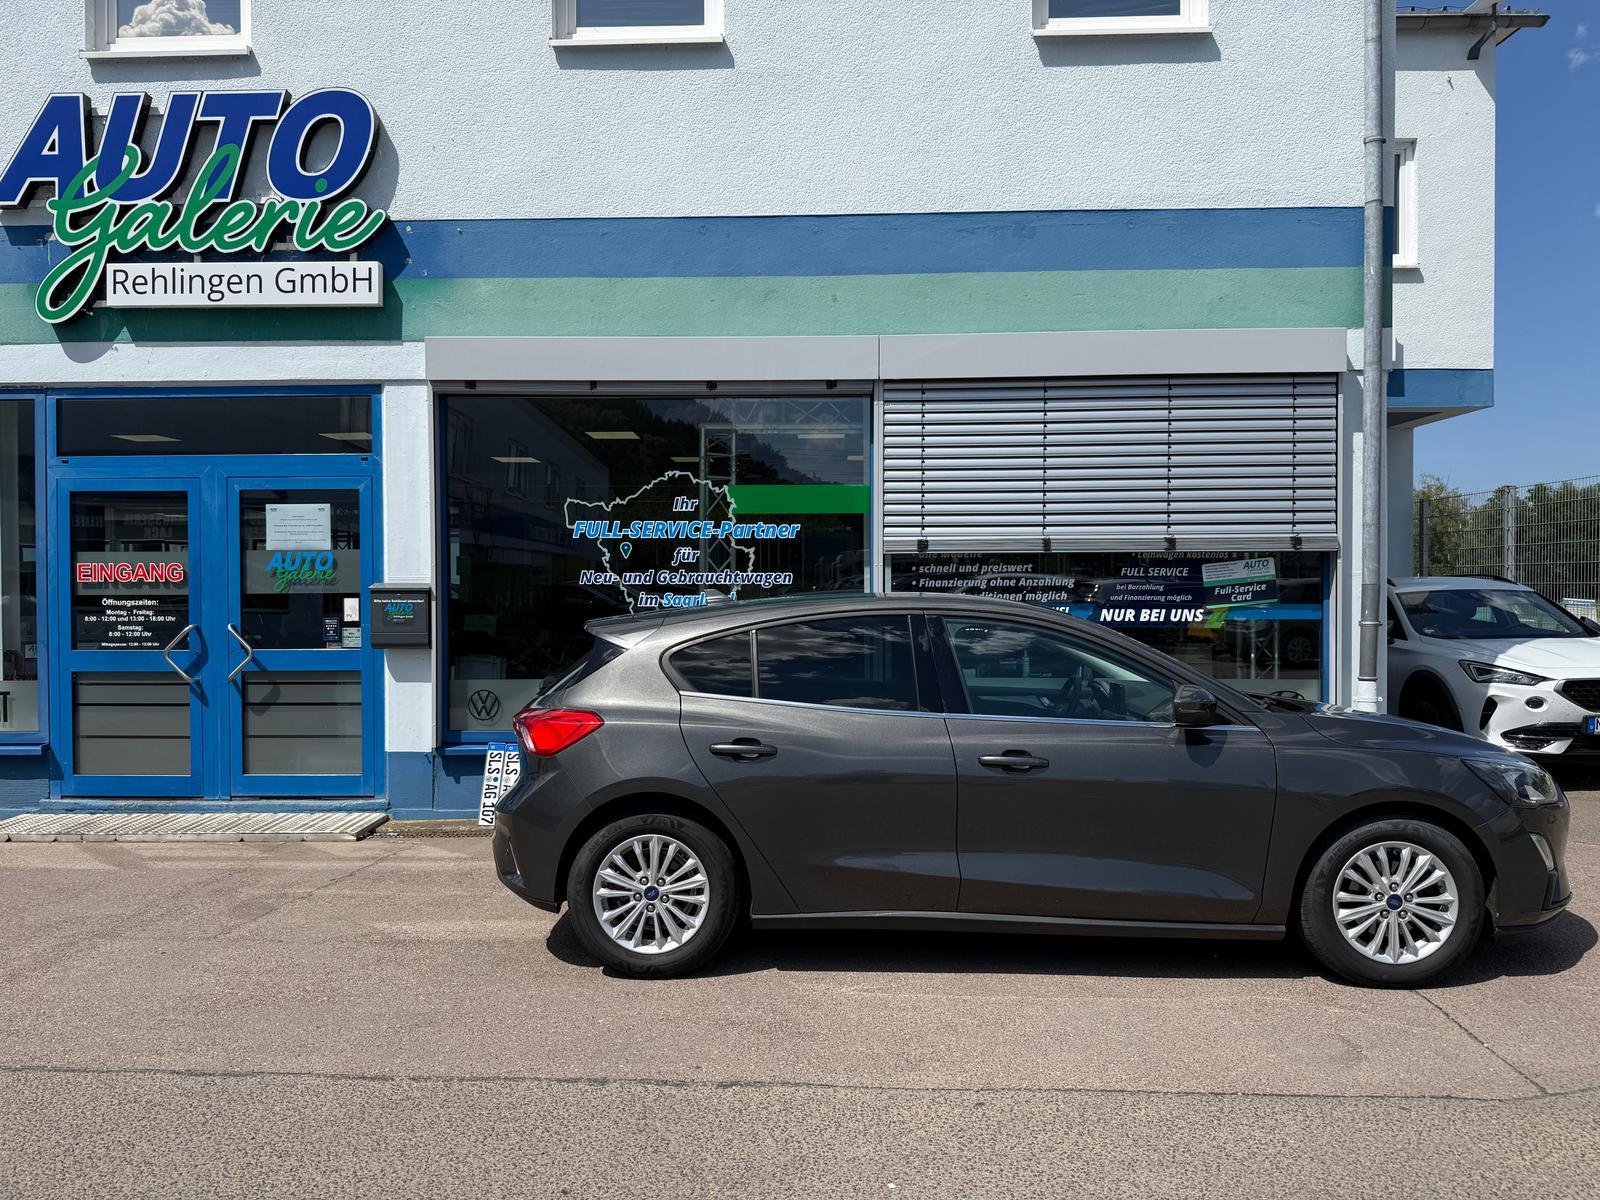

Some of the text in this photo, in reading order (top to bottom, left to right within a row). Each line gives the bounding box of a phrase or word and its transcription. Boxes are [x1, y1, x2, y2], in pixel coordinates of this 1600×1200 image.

[0, 88, 375, 205] AUTO
[112, 267, 373, 302] Rehlingen GmbH
[672, 496, 699, 512] Ihr
[572, 520, 801, 539] FULL-SERVICE-Partner
[266, 551, 334, 572] AUTO
[671, 547, 700, 567] für
[1243, 559, 1269, 569] AUTO
[76, 562, 184, 583] EINGANG
[918, 562, 1033, 575] schnell und preiswert
[1120, 567, 1189, 577] FULL SERVICE
[579, 569, 793, 589] Neu- und Gebrauchtwagen
[918, 576, 1075, 590] Finanzierung ohne Anzahlung
[1025, 590, 1067, 603] möglich
[1214, 583, 1267, 595] Full-Service
[1231, 592, 1252, 602] Card
[101, 598, 159, 607] Öffnungszeiten:
[637, 591, 660, 607] im
[1123, 594, 1166, 602] Finanzierung
[1166, 594, 1193, 602] möglich
[1099, 608, 1205, 622] NUR BEI UNS
[487, 752, 502, 775] SLS
[505, 753, 520, 776] SLS
[483, 783, 498, 799] AG
